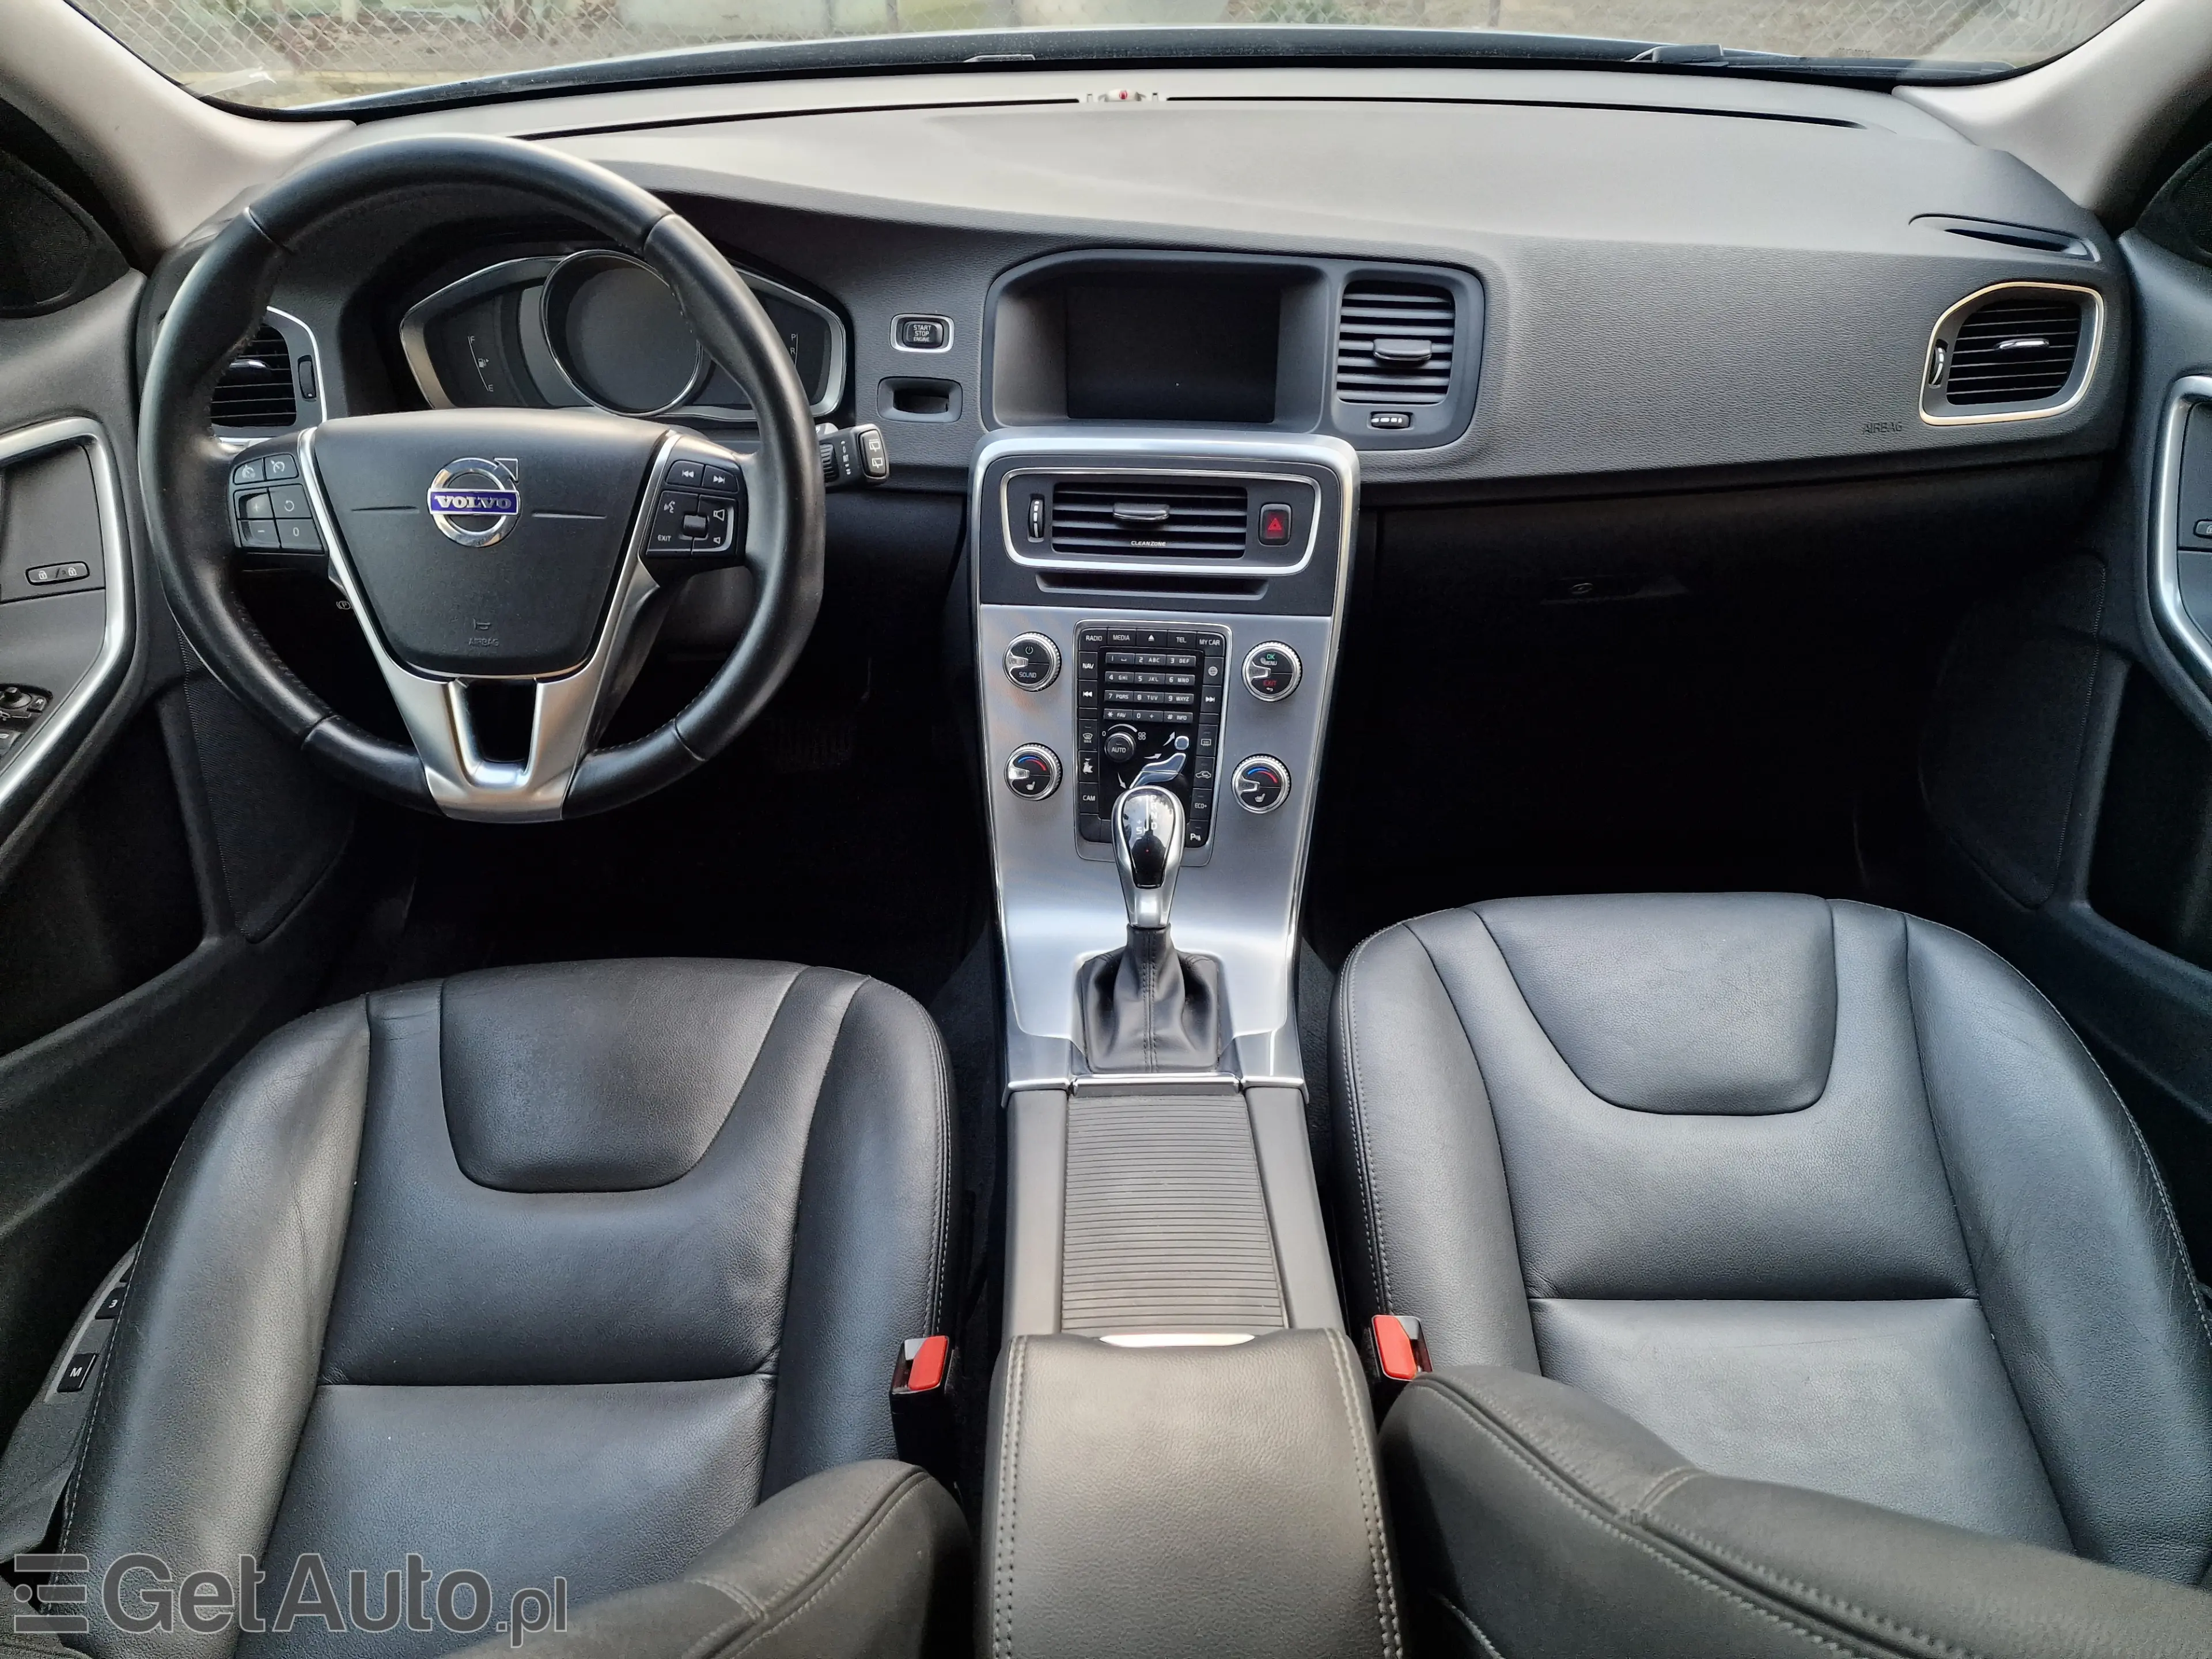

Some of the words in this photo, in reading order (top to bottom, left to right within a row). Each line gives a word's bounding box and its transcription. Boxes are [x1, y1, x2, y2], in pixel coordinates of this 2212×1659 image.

[434, 495, 512, 509] VOLVO
[1151, 822, 1157, 830] D
[1136, 827, 1142, 835] S
[70, 1366, 81, 1377] M
